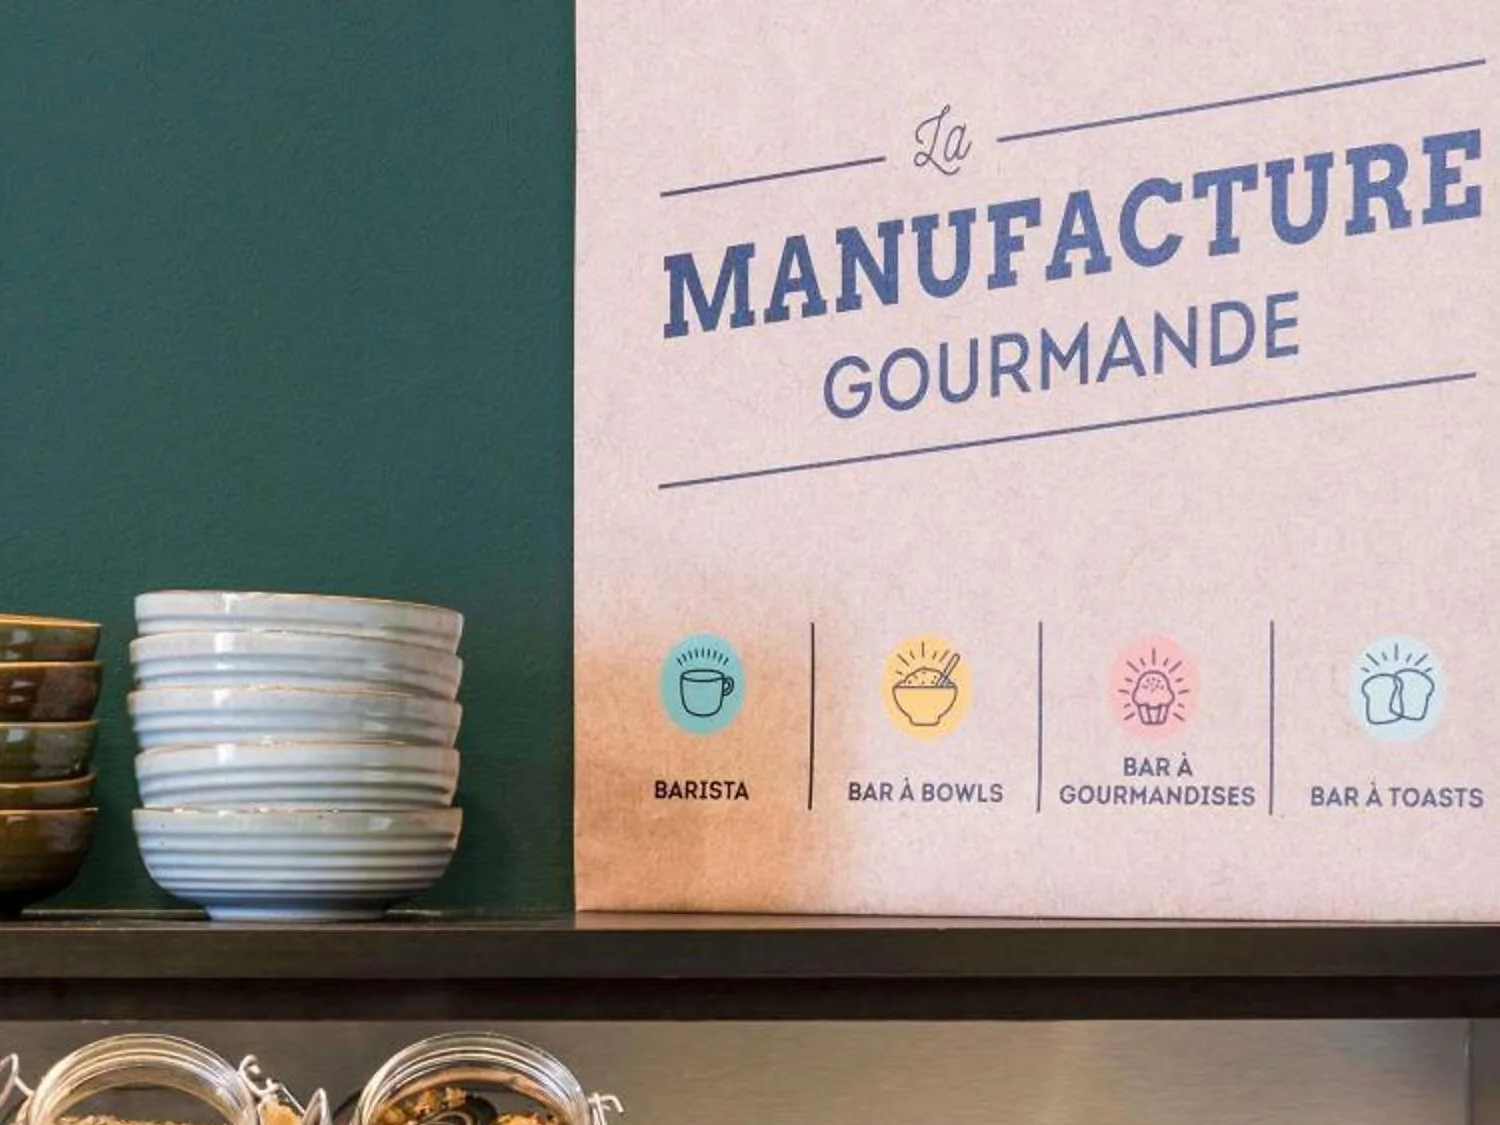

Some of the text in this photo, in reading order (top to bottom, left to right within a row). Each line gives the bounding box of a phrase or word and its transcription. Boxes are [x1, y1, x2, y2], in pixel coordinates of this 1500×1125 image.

[913, 104, 972, 176] La
[662, 128, 1484, 341] MANUFACTURE
[822, 291, 1300, 420] GOURMANDE
[1122, 751, 1194, 777] BAR À
[654, 780, 750, 801] BARISTA
[847, 776, 1004, 803] BAR À BOWLS
[1058, 785, 1256, 807] GOURMANDISES
[1310, 781, 1485, 809] BAR À TOASTS
